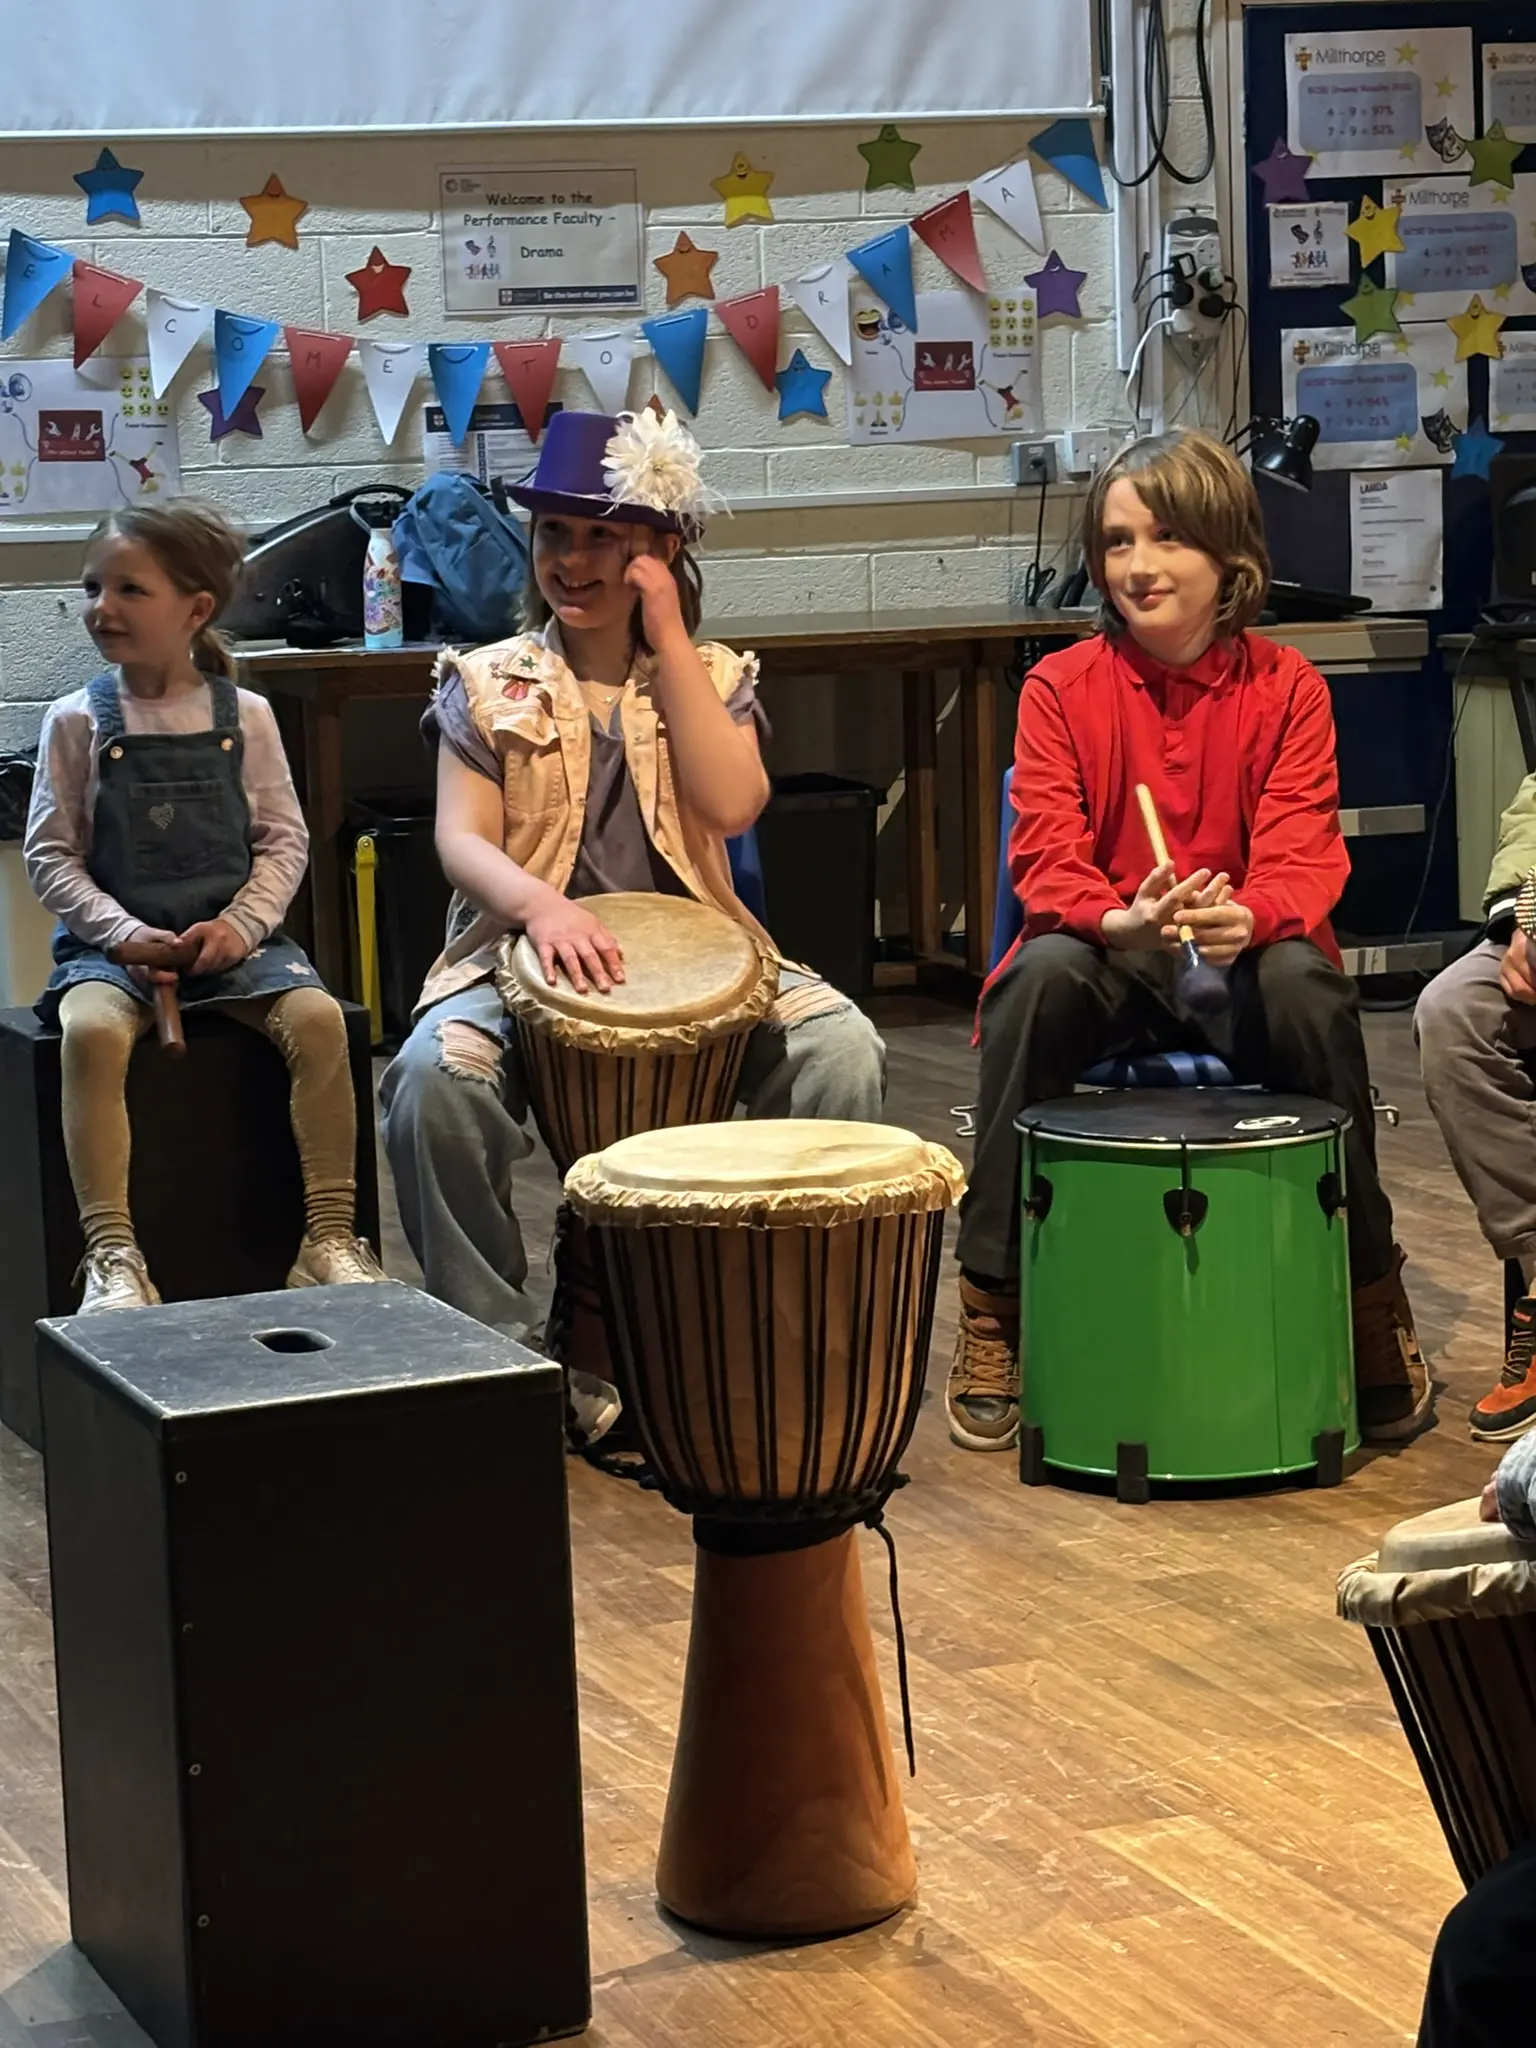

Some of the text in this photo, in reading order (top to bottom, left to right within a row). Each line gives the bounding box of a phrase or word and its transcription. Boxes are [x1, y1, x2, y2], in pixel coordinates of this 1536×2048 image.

[486, 191, 593, 206] Welcome to the
[463, 212, 548, 228] Performance
[553, 212, 603, 227] Faculty
[520, 246, 564, 259] Drama
